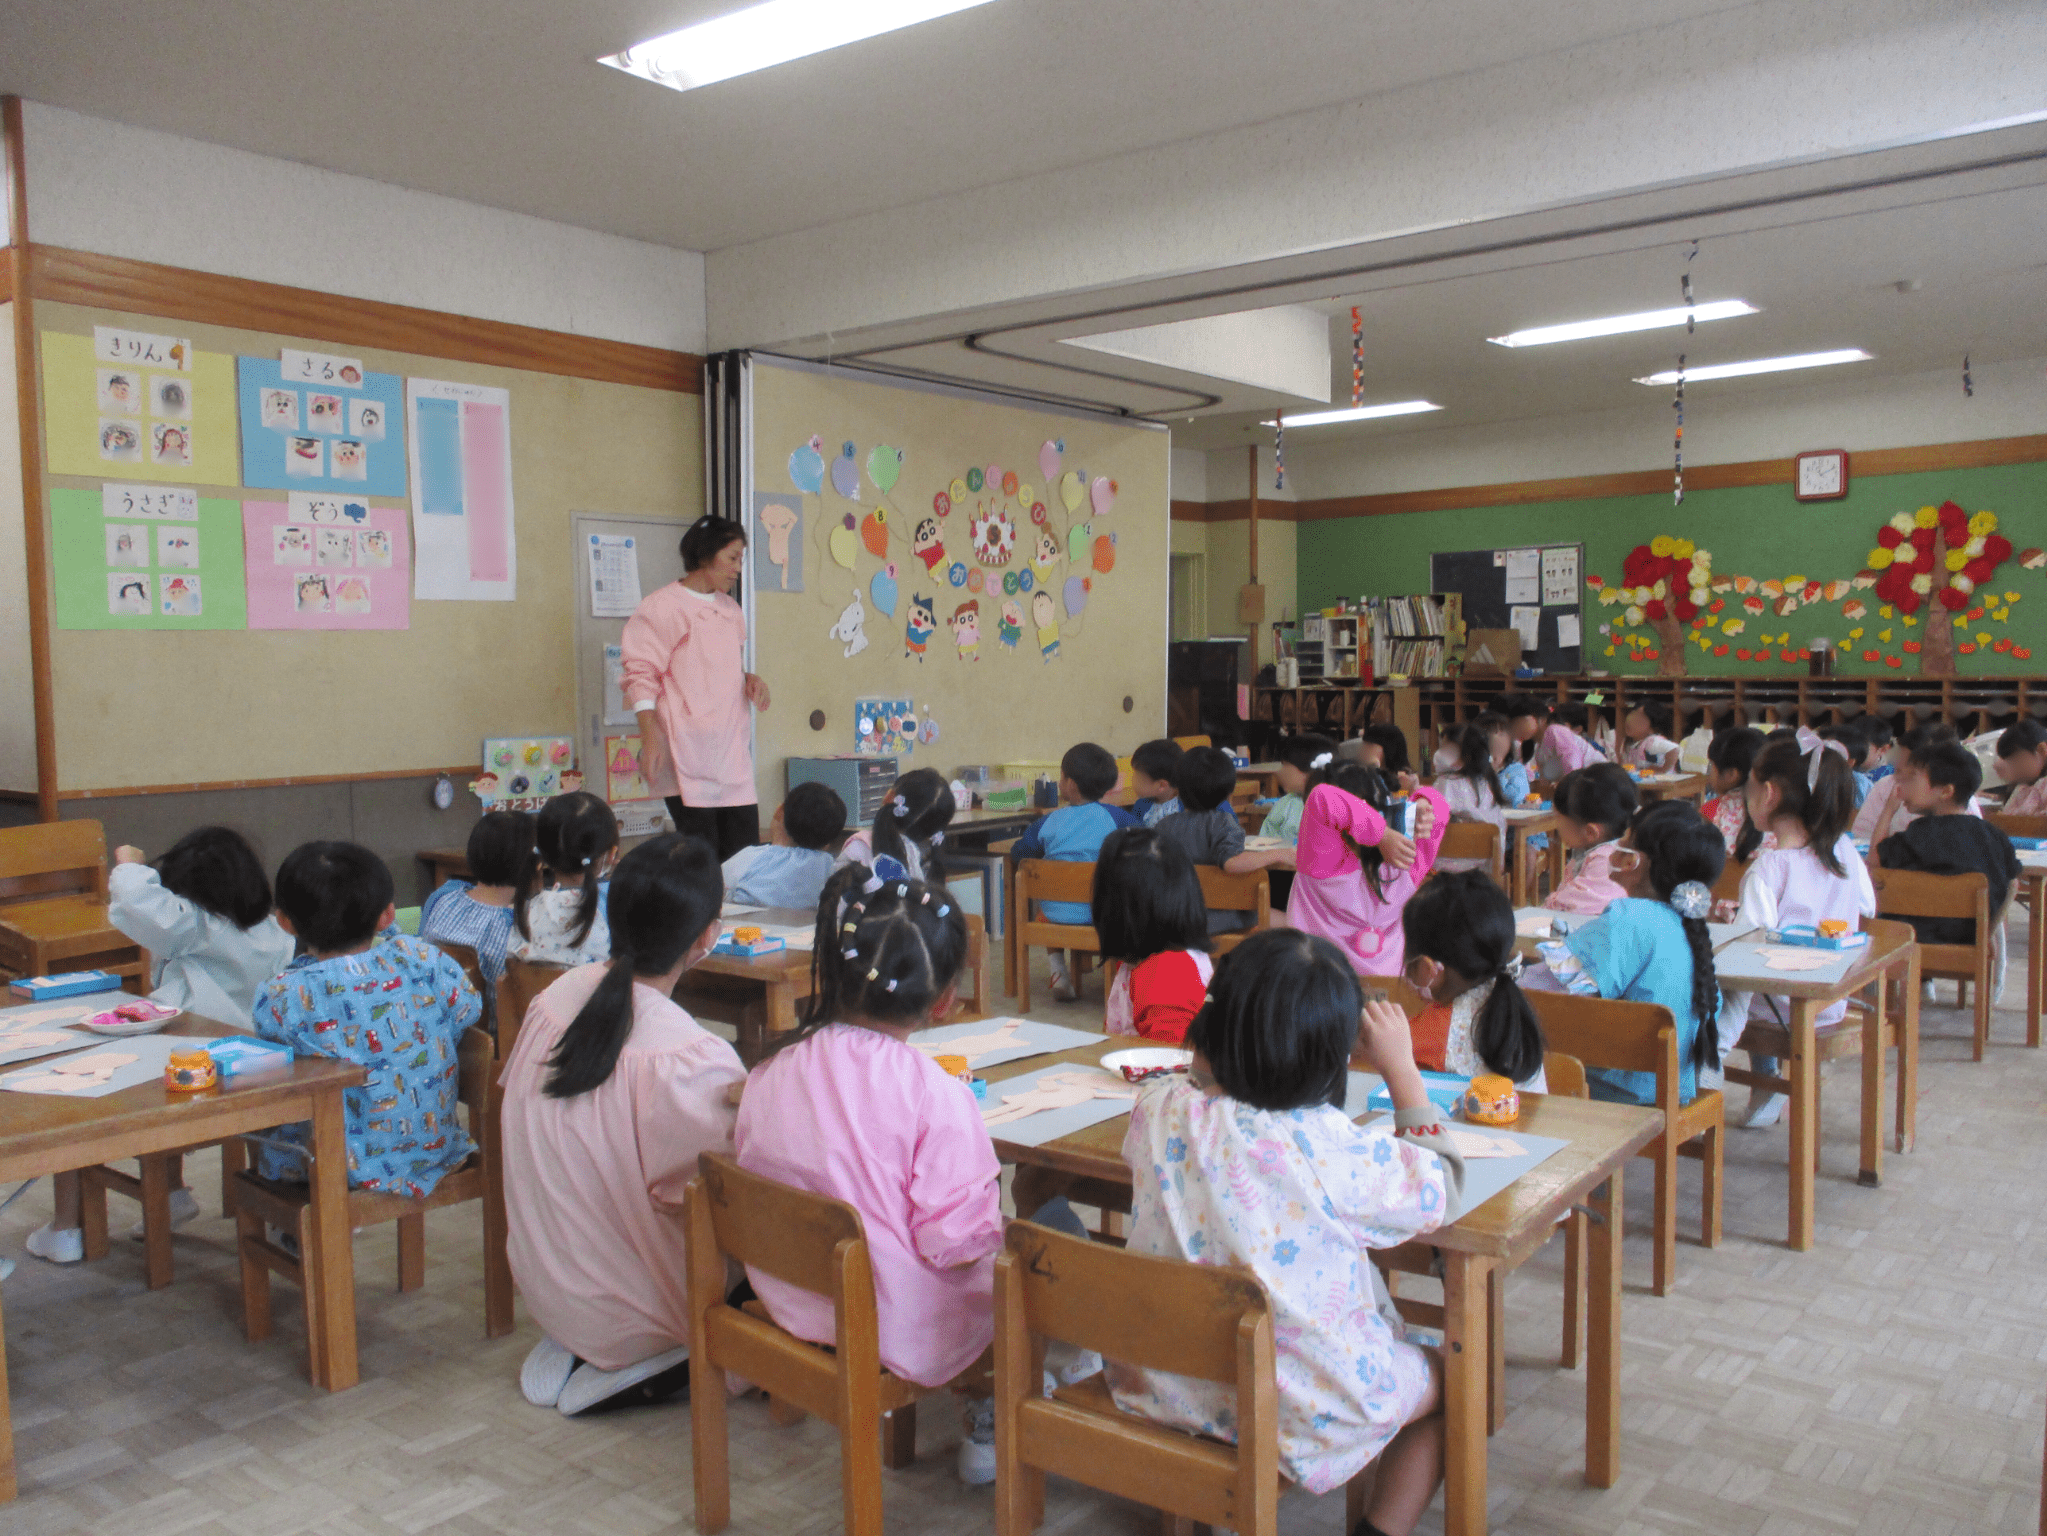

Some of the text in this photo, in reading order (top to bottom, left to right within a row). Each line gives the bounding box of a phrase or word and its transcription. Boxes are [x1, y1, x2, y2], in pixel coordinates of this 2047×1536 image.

[111, 336, 163, 363] きりん
[302, 360, 334, 380] さる
[897, 450, 903, 462] 6
[123, 492, 175, 515] うさぎ
[309, 500, 338, 521] ぞう
